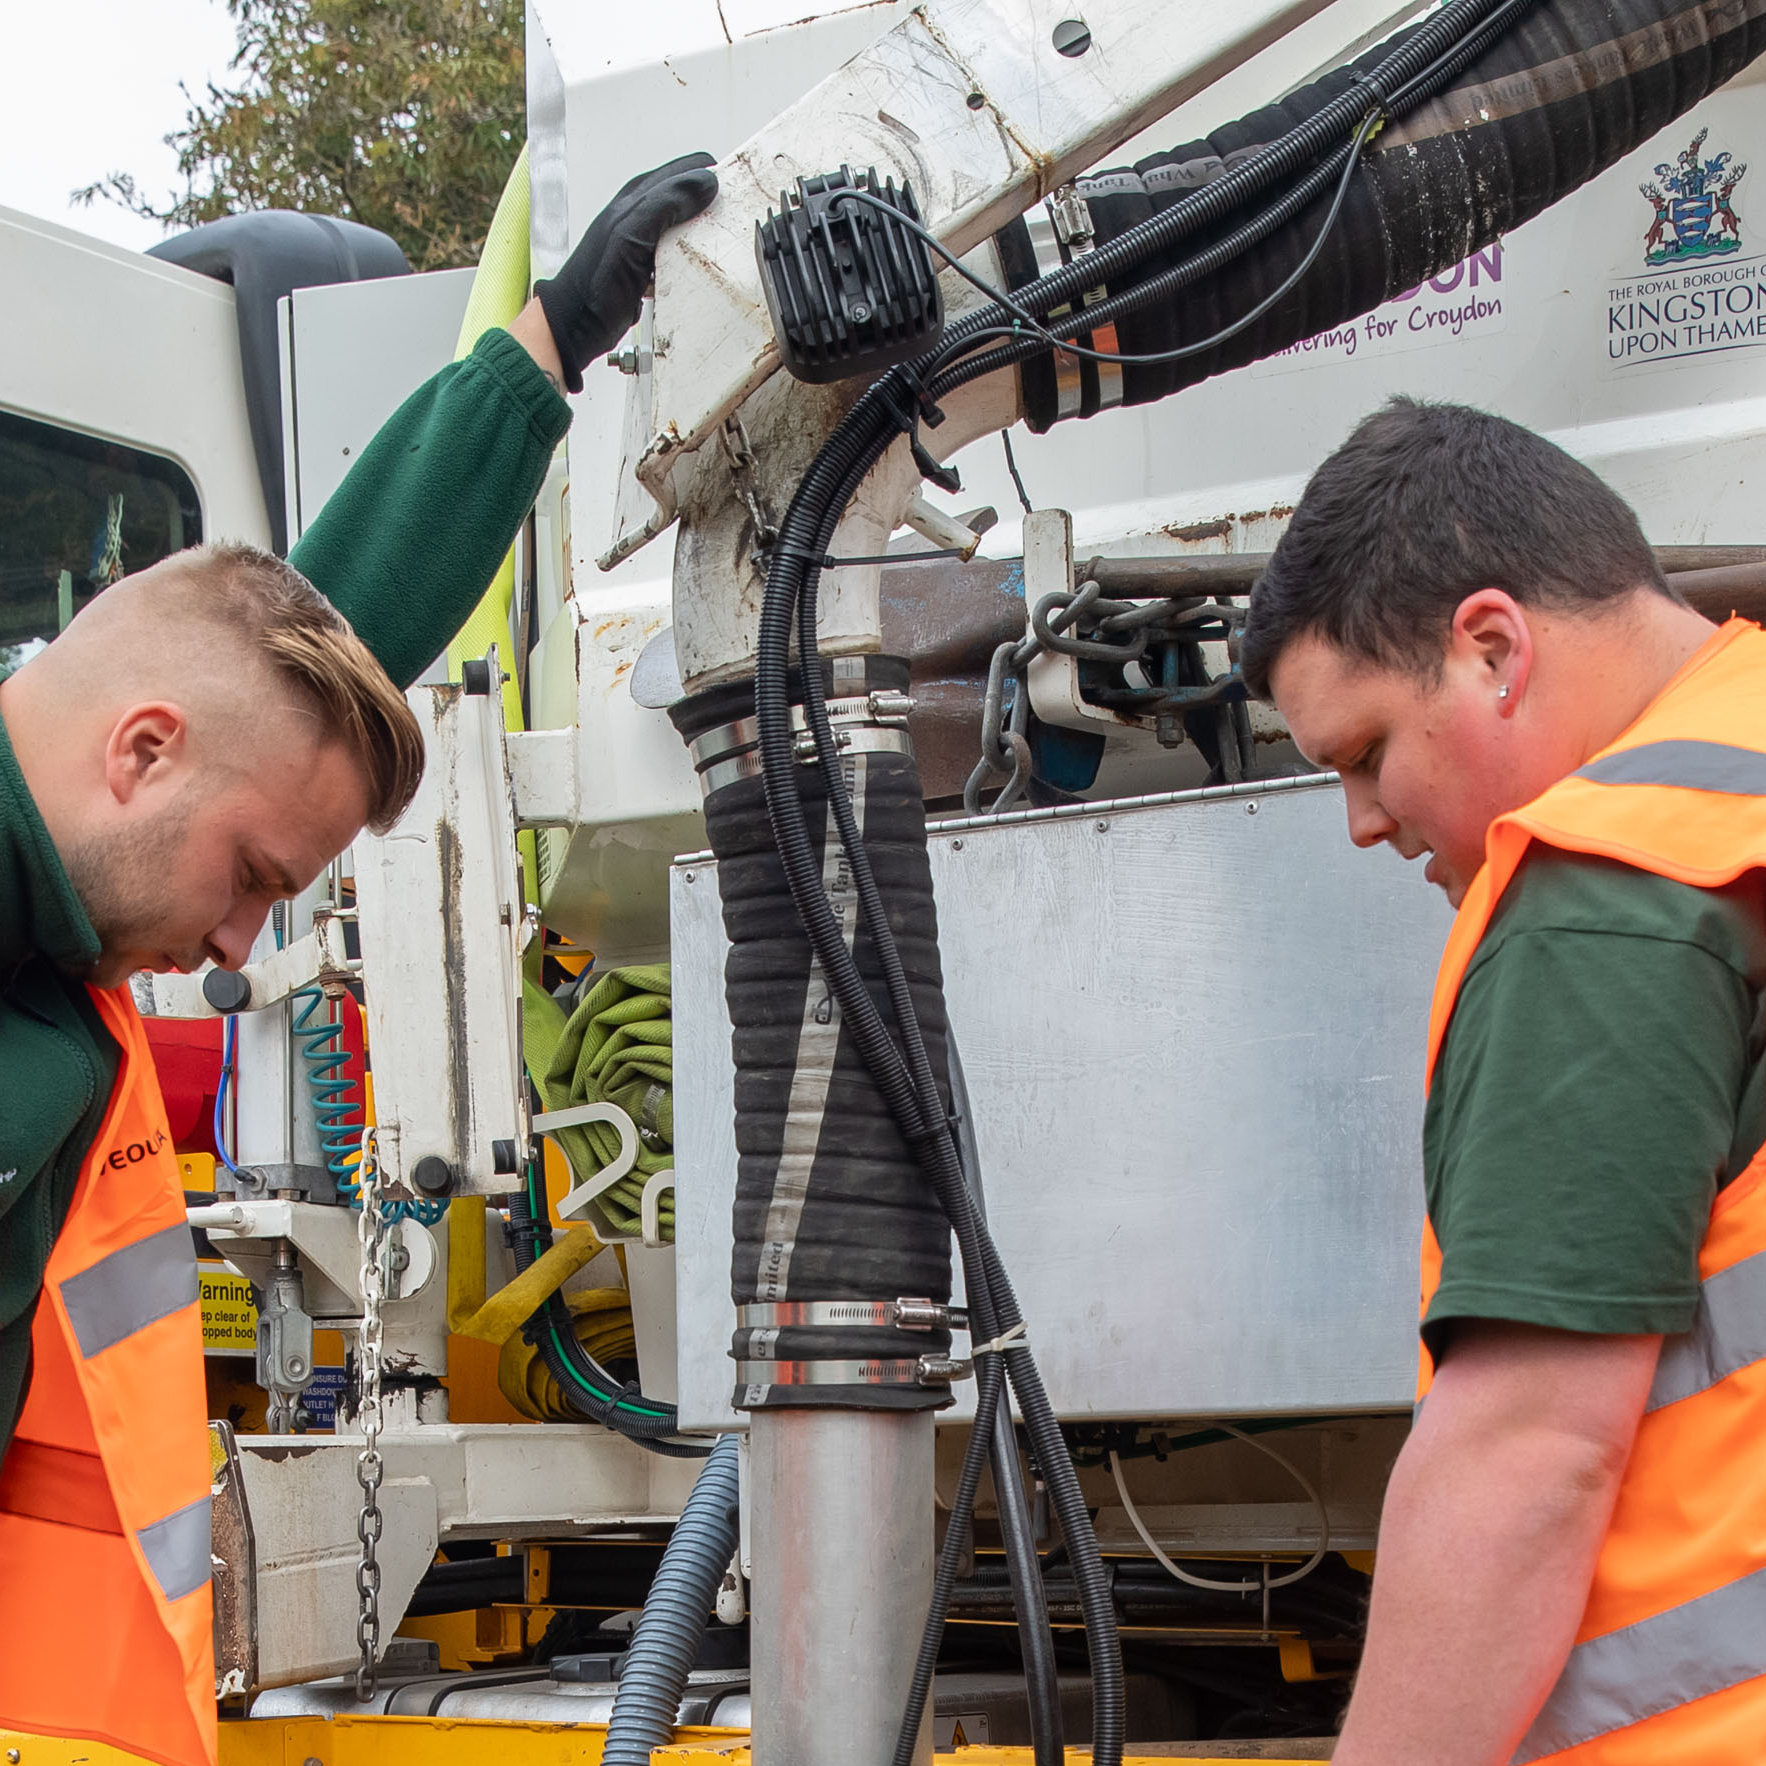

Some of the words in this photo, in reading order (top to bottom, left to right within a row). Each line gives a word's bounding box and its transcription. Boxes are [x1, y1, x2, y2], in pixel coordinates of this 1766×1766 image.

[1608, 287, 1633, 302] THE
[1637, 280, 1679, 297] ROYAL
[1683, 269, 1755, 291] BOROUGH
[1365, 314, 1397, 340] for
[1408, 295, 1502, 335] Croydon
[1608, 331, 1676, 360] UPON
[761, 1242, 784, 1303] imited
[216, 1311, 236, 1324] clear
[240, 1311, 250, 1324] of
[312, 1375, 336, 1384] NSURE
